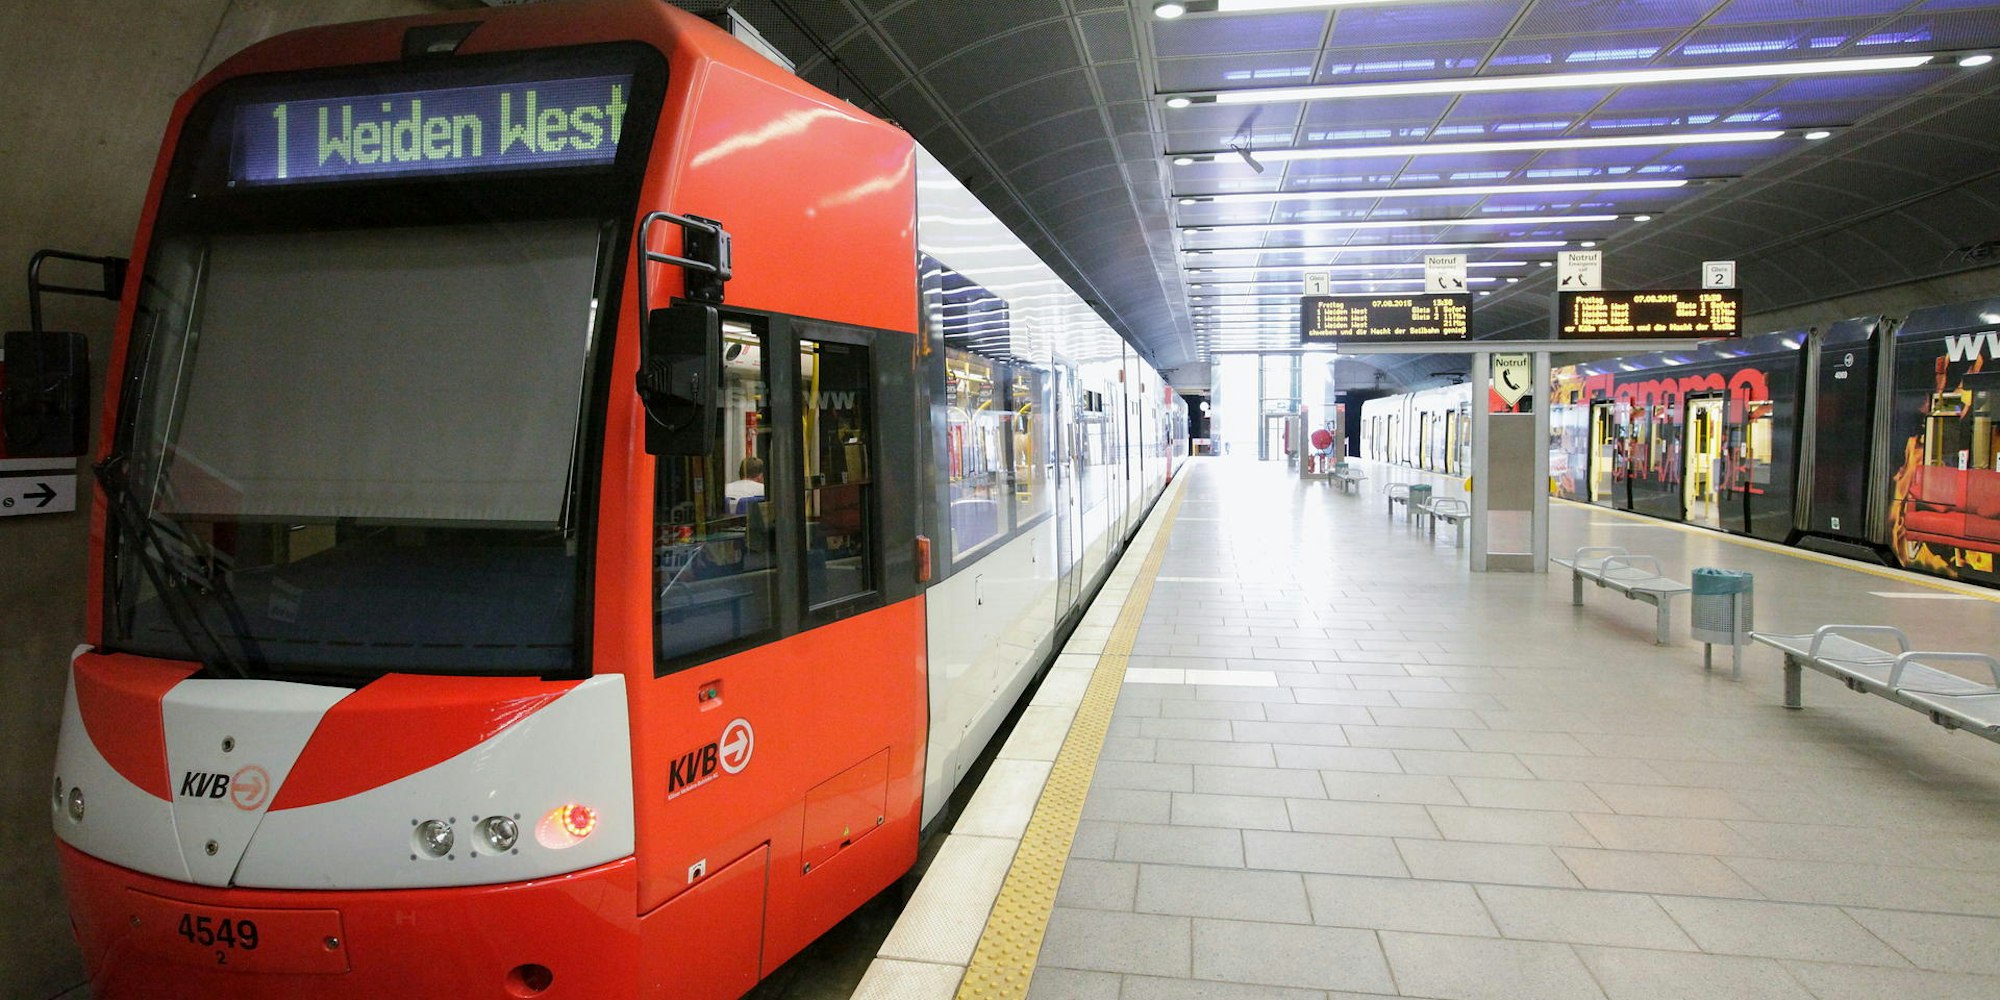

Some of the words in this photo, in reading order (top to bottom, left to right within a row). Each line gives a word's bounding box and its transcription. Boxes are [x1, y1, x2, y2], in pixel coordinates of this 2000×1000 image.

[273, 104, 287, 179] 1
[318, 99, 482, 166] Weiden
[500, 84, 627, 156] West
[1428, 257, 1456, 265] Notruf
[1568, 253, 1597, 261] Notruf
[1715, 274, 1724, 284] 2
[1314, 282, 1320, 292] 1
[1496, 357, 1527, 367] Notruf
[668, 742, 718, 793] KVB
[180, 771, 230, 799] KVB
[178, 913, 258, 950] 4549
[216, 951, 227, 965] 2
